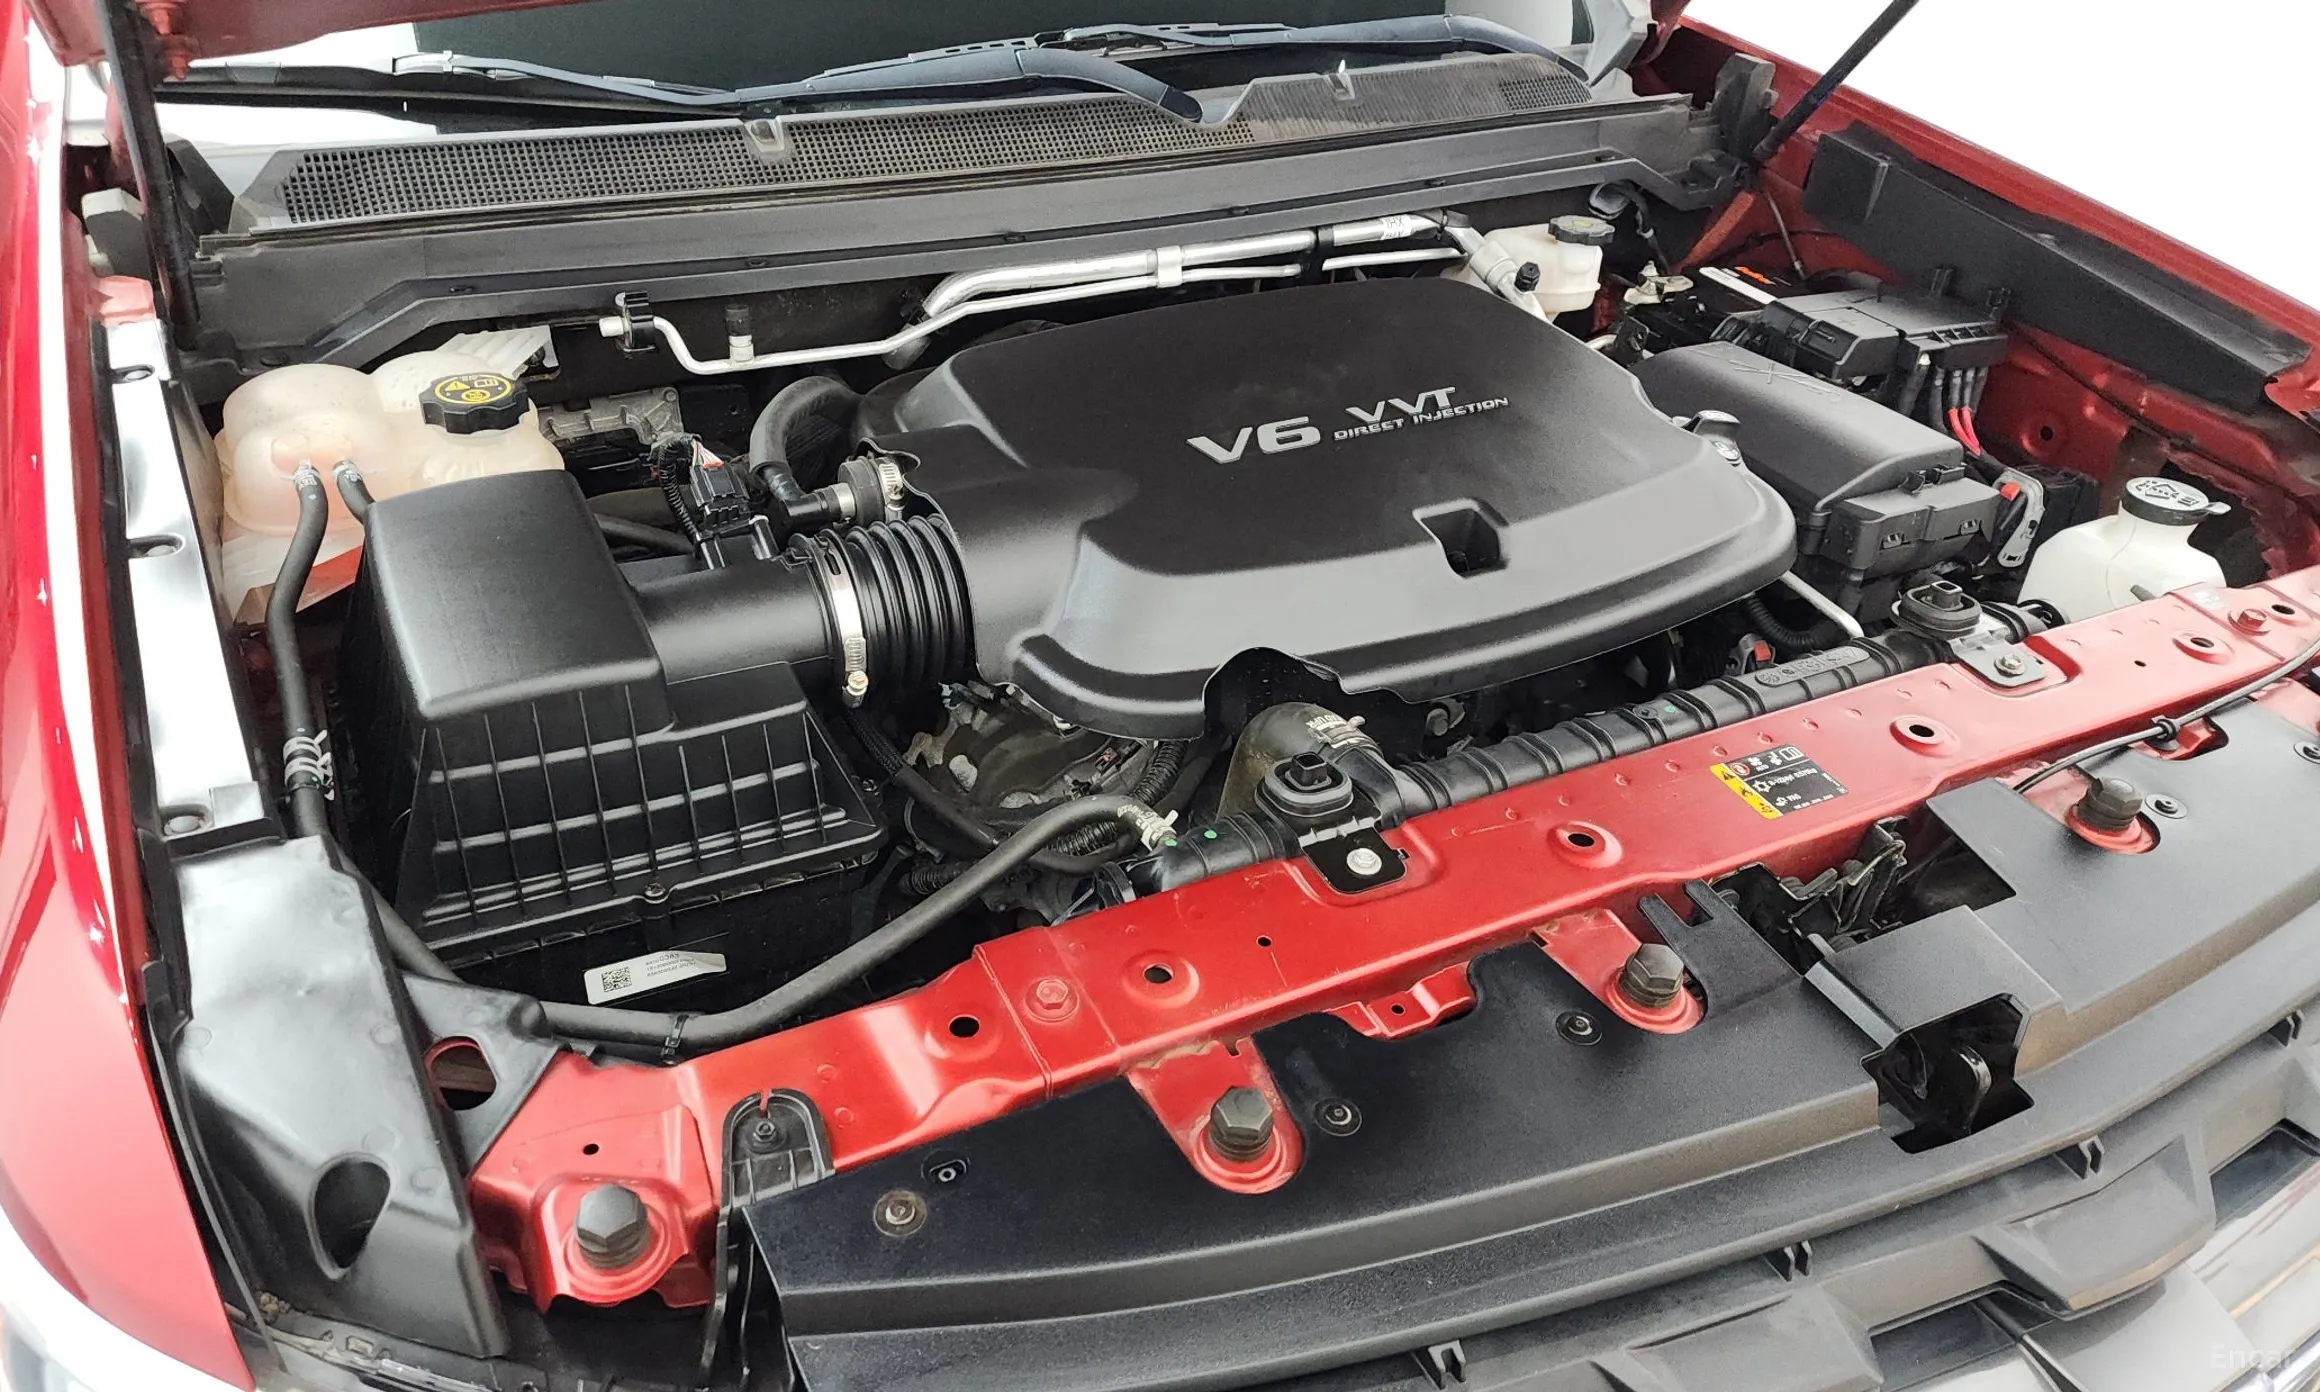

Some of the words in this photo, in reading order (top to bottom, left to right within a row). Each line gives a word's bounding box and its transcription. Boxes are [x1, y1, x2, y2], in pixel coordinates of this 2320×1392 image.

[1333, 418, 1404, 441] DIRECT
[1411, 397, 1509, 424] INJECTION
[1345, 387, 1456, 424] VVT
[1186, 416, 1321, 464] V6
